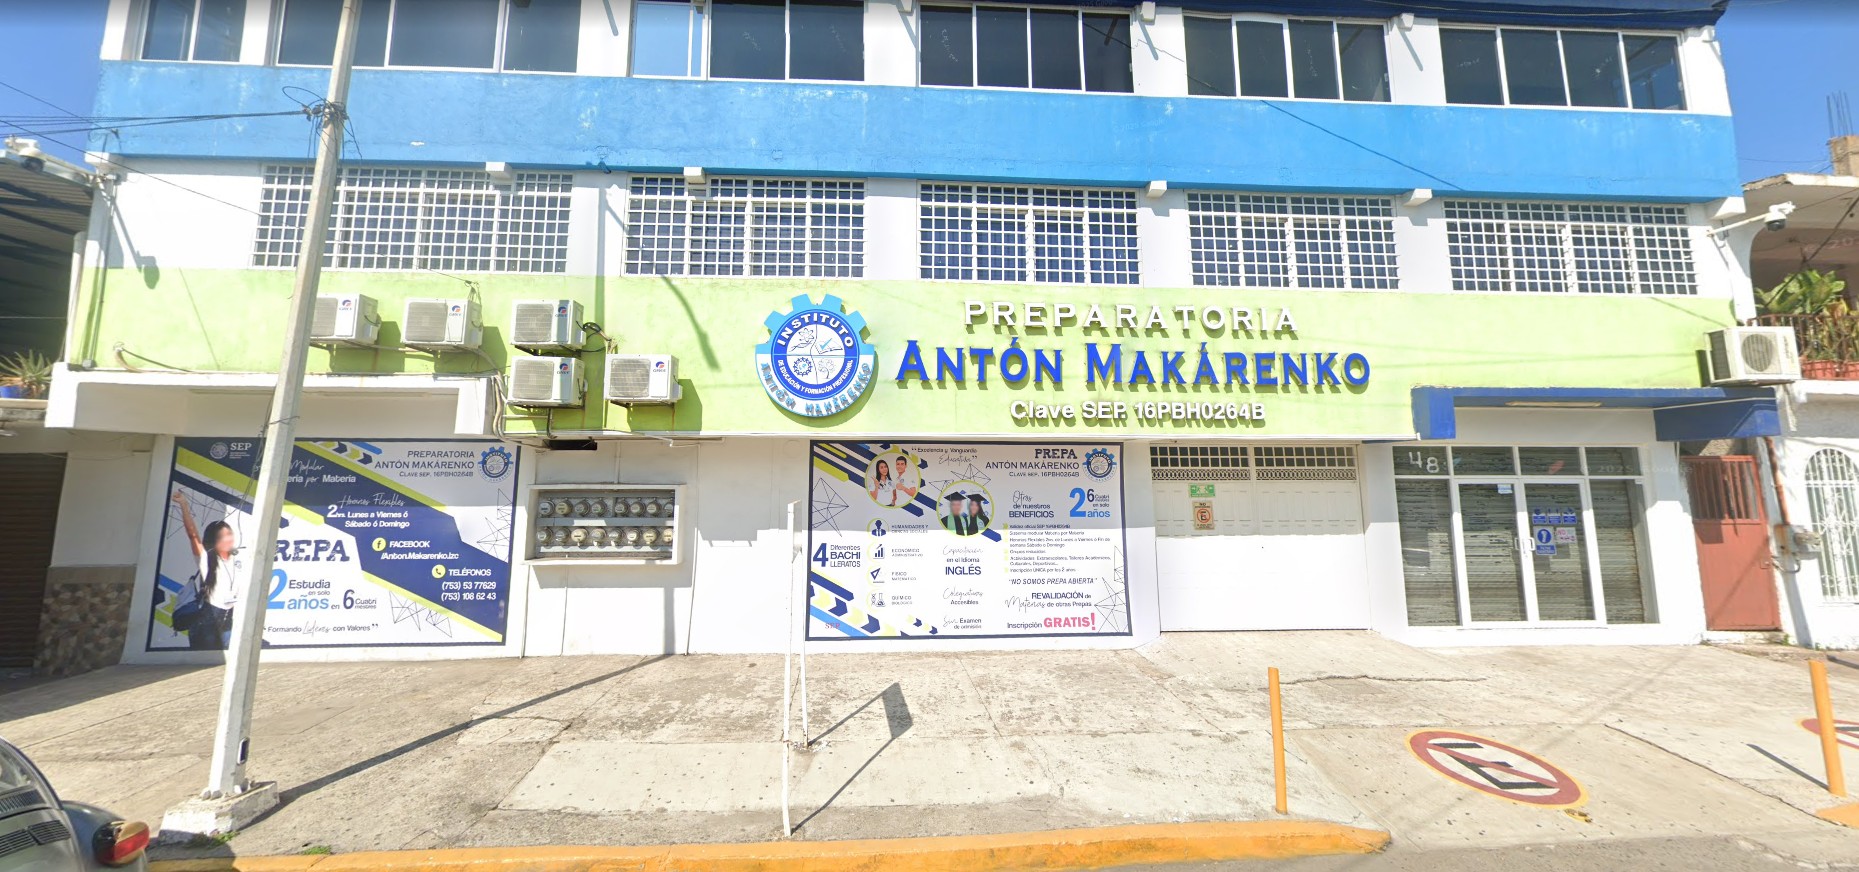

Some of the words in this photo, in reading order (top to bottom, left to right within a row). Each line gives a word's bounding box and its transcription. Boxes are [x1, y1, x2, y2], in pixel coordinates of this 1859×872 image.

[965, 301, 1298, 331] PREPARATORIA
[777, 313, 854, 347] INSTITUTO
[896, 337, 1063, 383] ANTÓN
[1085, 342, 1371, 386] MAKÁRENKO
[804, 385, 833, 395] FORMACIÓN
[832, 359, 854, 390] PROFESIONAL
[1010, 401, 1075, 419] Clave
[1082, 401, 1127, 419] SEP.
[1134, 401, 1266, 420] 16PBH0264B
[230, 442, 252, 451] SEP
[407, 451, 475, 459] PREPARATORIA
[1034, 448, 1078, 459] PREPA
[374, 459, 412, 469] ANTÓN
[412, 459, 475, 469] MAKÁRENKO
[985, 460, 1018, 469] ANTÓN
[1019, 460, 1079, 470] MAKÁRENKO
[322, 475, 356, 483] Materia
[1087, 489, 1095, 502] 6
[1070, 487, 1086, 518] 2
[1087, 509, 1111, 518] años
[345, 520, 371, 528] Sábado
[379, 521, 410, 529] Domingo
[273, 539, 350, 562] REPA
[813, 543, 828, 567] 4
[830, 551, 861, 560] BACHI
[448, 568, 491, 576] TELÉFONOS
[945, 563, 982, 576] INGLÉS
[289, 579, 331, 589] Estudia
[442, 581, 461, 590] (753)
[474, 581, 497, 590] 77629
[1022, 577, 1045, 585] SOMOS
[1047, 577, 1067, 585] PREPA
[266, 568, 288, 610] 2
[287, 595, 329, 610] años
[343, 589, 355, 610] 6
[441, 592, 461, 601] (753)
[487, 592, 497, 600] 43
[1031, 590, 1084, 599] REVALIDACIÓN
[1043, 612, 1096, 631] GRATIS!
